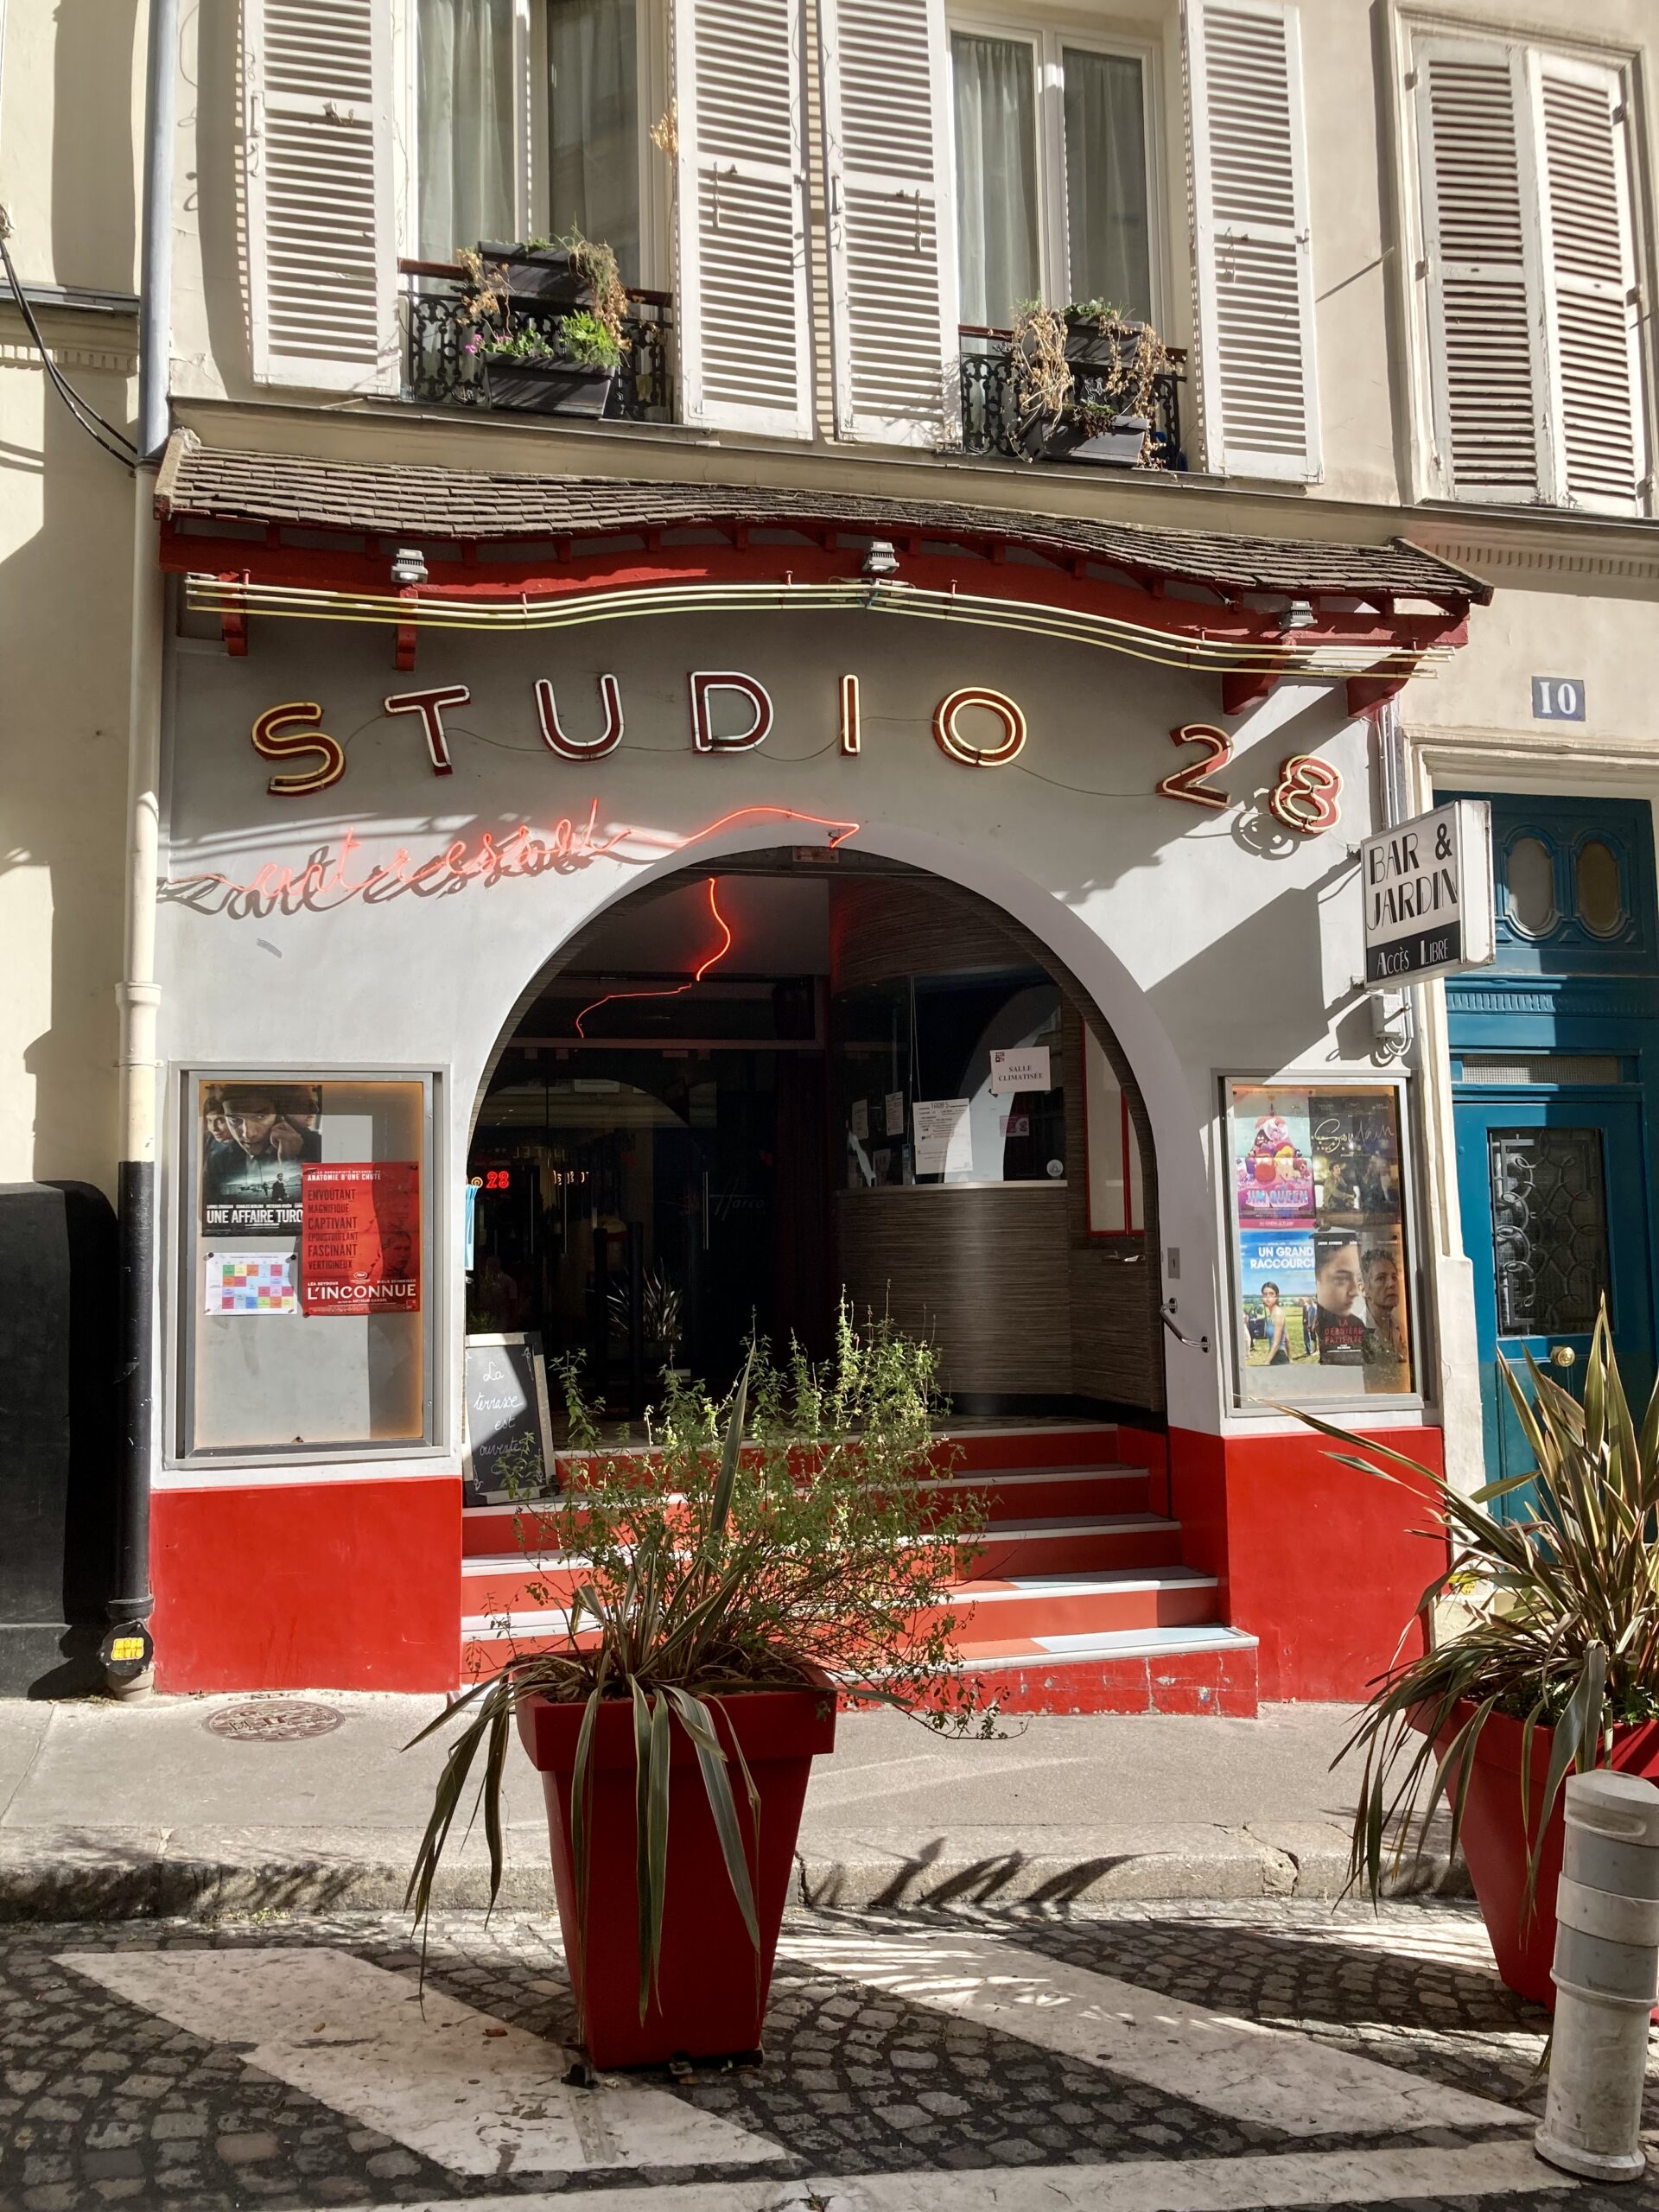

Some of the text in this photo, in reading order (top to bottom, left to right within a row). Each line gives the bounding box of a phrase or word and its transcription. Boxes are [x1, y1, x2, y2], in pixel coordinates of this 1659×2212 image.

[1540, 681, 1577, 715] 10
[251, 671, 1344, 835] STUDIO 28
[1369, 823, 1452, 886] BAR &
[1366, 864, 1459, 931] JARDIN
[1376, 938, 1449, 976] ACCÈS LIBRE
[998, 1071, 1044, 1082] CLIMATISÉE
[307, 1173, 340, 1182] ANATOMIE
[486, 1170, 511, 1190] 28
[308, 1188, 356, 1201] ENVOÛTANT
[1247, 1189, 1308, 1204] JIM QUEEN
[207, 1210, 229, 1224] UNE
[231, 1209, 275, 1224] AFFAIRE
[308, 1203, 350, 1214] MAGNIFIQUE
[308, 1217, 358, 1230] CAPTIVANT
[308, 1243, 358, 1257] FASCINANT
[1258, 1246, 1314, 1257] UN GRAND
[308, 1259, 353, 1270] VERTIGINEUX
[307, 1284, 416, 1300] L'INCONNUE
[482, 1361, 505, 1382] La
[473, 1391, 524, 1411] terrasse
[494, 1416, 517, 1432] est
[479, 1436, 522, 1457] ouverte
